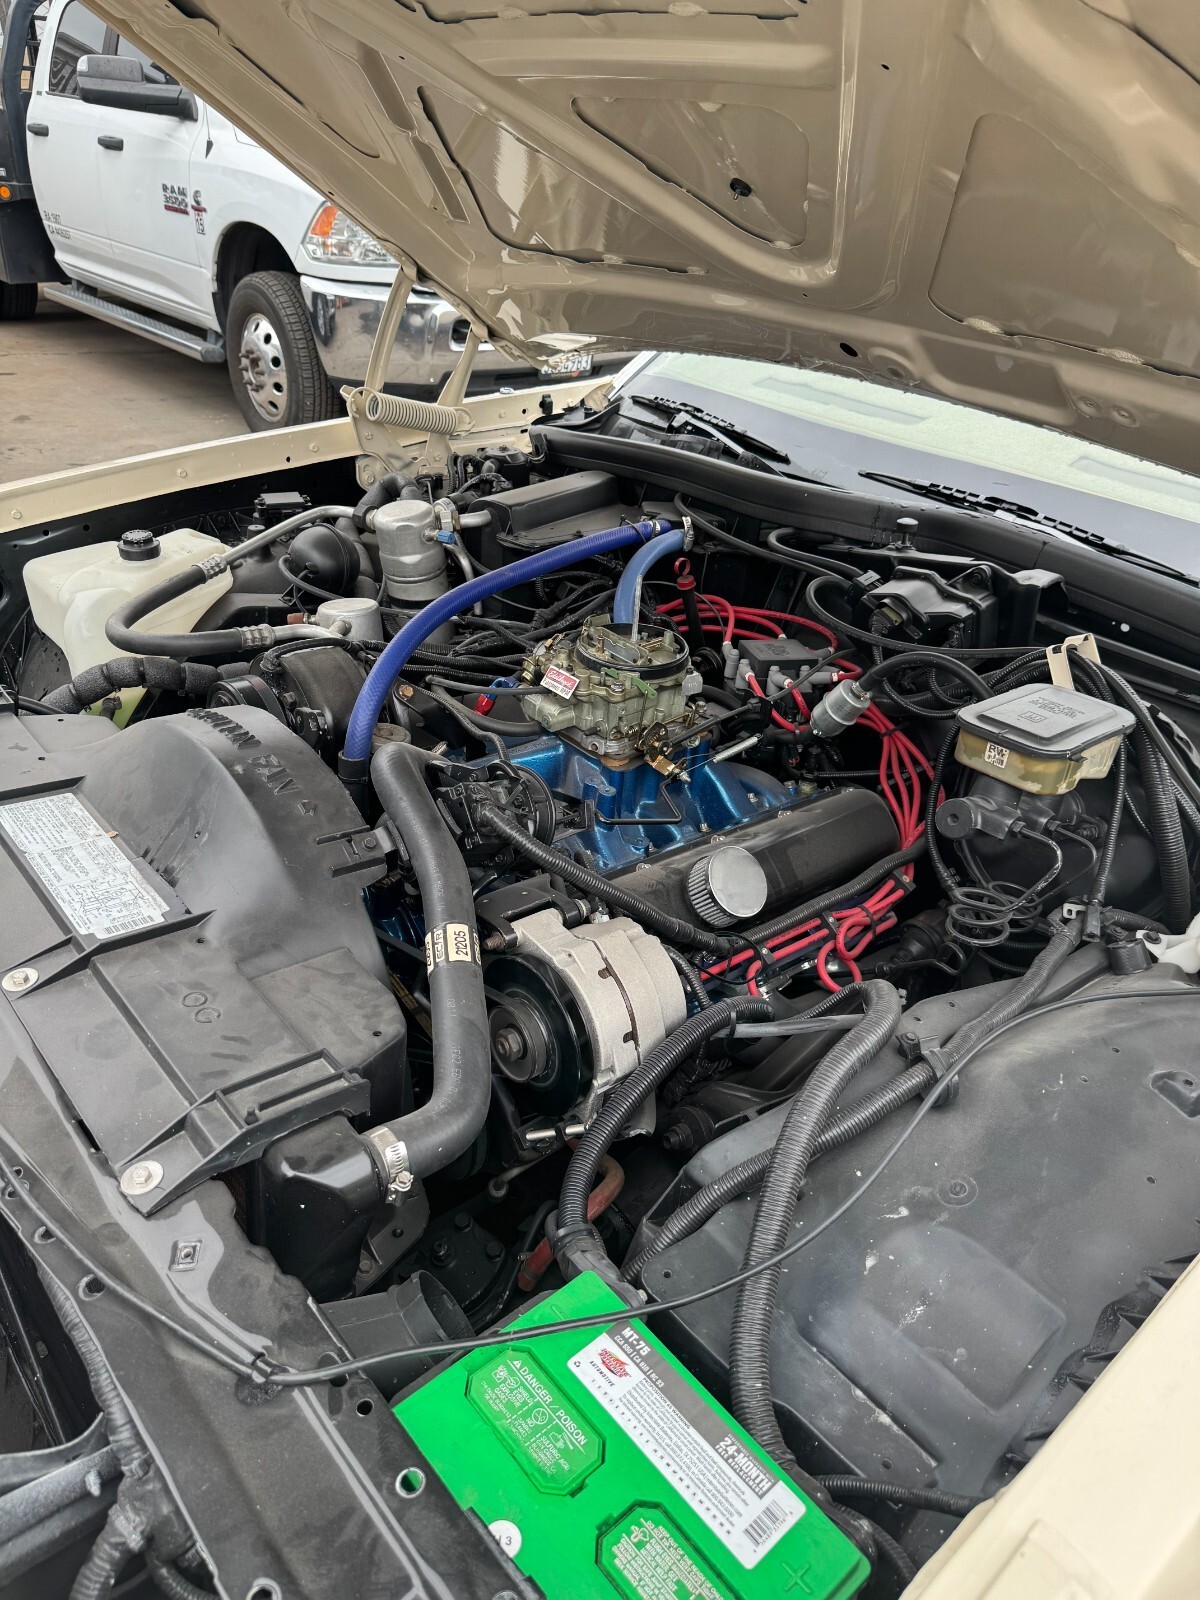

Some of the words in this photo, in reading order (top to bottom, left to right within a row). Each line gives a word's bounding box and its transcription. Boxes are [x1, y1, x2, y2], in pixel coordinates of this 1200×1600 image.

[162, 183, 187, 198] RAM
[454, 930, 468, 956] 21205
[620, 1326, 652, 1356] MT-75
[588, 1359, 615, 1387] AUTOMOTIVE
[601, 1347, 630, 1377] INTERSTATE
[613, 1334, 625, 1345] CCA
[621, 1342, 633, 1354] 650
[632, 1354, 642, 1363] CA
[648, 1372, 659, 1382] RC
[655, 1378, 664, 1388] 93
[493, 1387, 508, 1403] GASES
[498, 1383, 521, 1408] EXPLOSIVE
[511, 1389, 525, 1403] EYES
[516, 1385, 533, 1403] SHIELD
[519, 1366, 553, 1404] DANGER
[555, 1408, 588, 1446] POISON
[641, 1377, 668, 1404] PROPOSITION
[671, 1408, 691, 1429] WARNING
[525, 1417, 535, 1427] NO
[540, 1434, 561, 1459] SULFURIC
[558, 1456, 570, 1471] ACID
[717, 1435, 772, 1492] 24-MONTH
[714, 1444, 729, 1459] FREE
[726, 1457, 763, 1496] REPLACEMENT
[505, 1535, 512, 1546] 3
[648, 1537, 664, 1554] FLUSH
[660, 1551, 674, 1565] EYES
[667, 1537, 677, 1548] OUT
[682, 1554, 692, 1565] THE
[638, 1547, 658, 1568] MEDICAL
[654, 1565, 668, 1580] HELP
[643, 1542, 657, 1556] WITH
[666, 1569, 678, 1582] GET
[678, 1558, 691, 1572] VENT
[689, 1570, 702, 1585] CAPS
